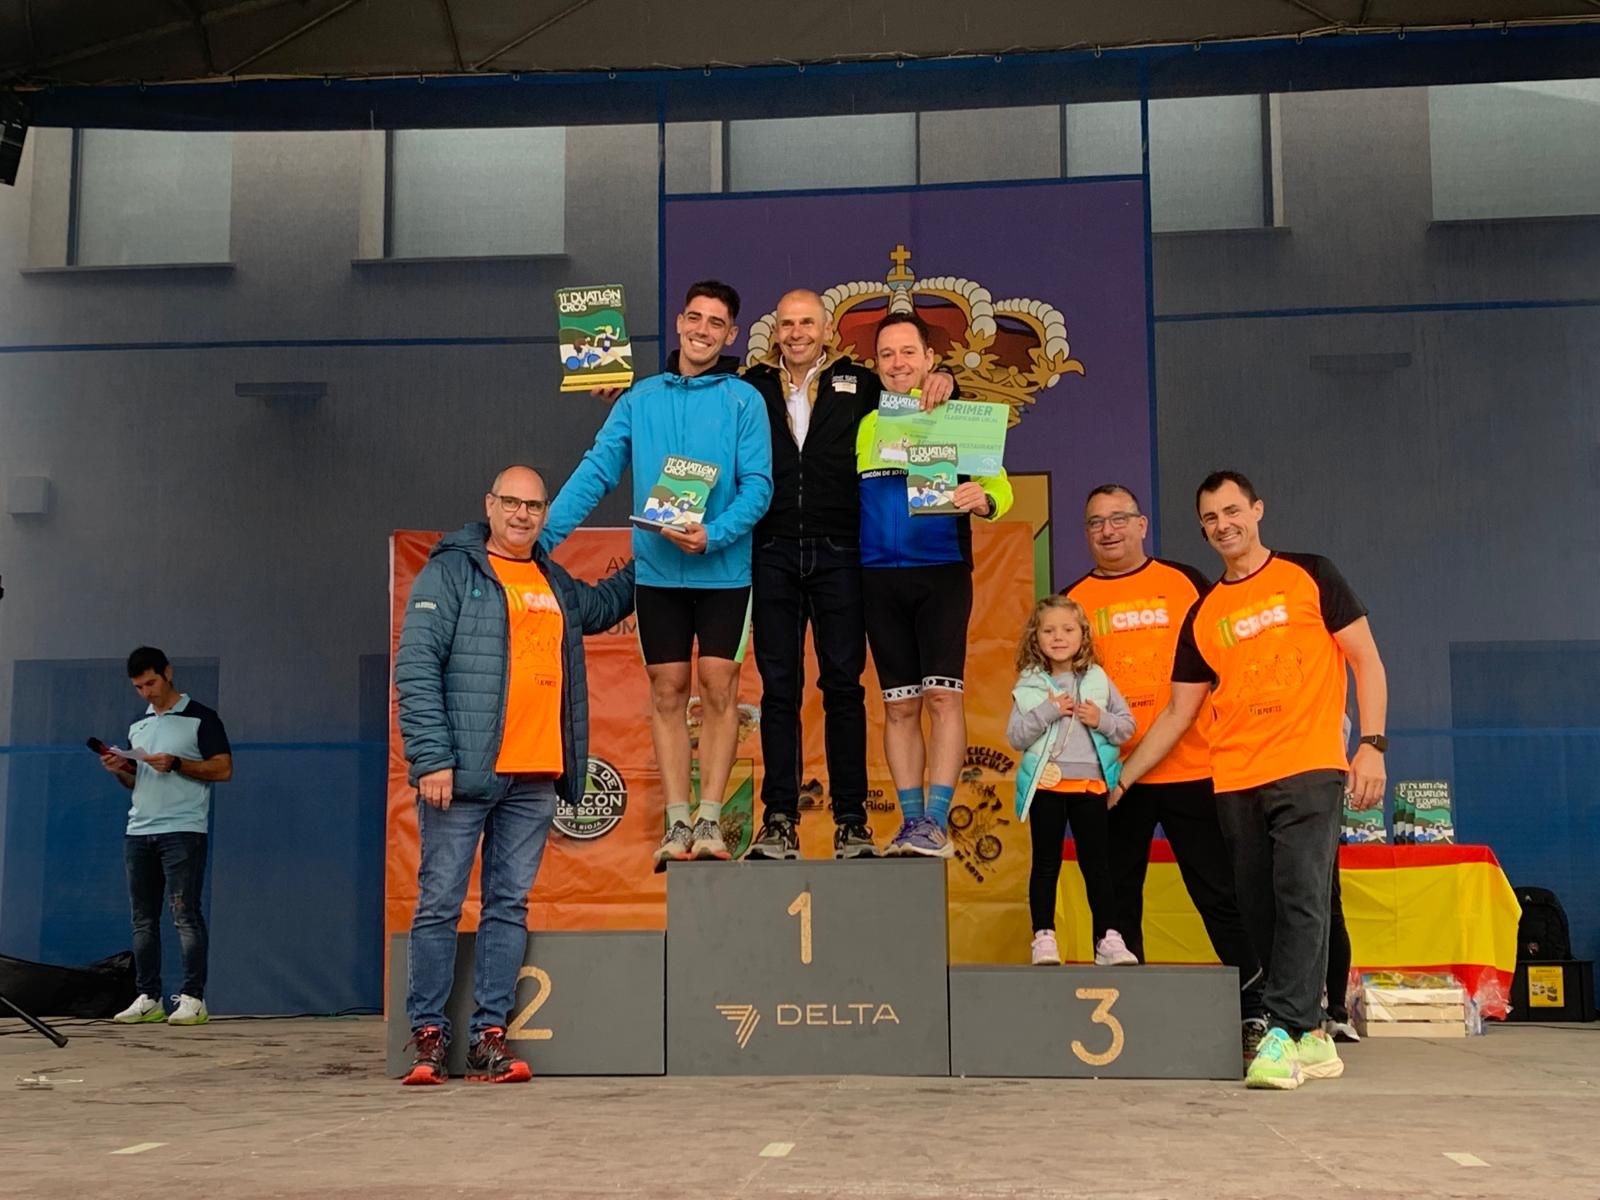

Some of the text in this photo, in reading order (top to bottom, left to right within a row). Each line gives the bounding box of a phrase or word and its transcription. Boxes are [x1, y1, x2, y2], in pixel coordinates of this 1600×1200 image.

[560, 303, 587, 312] CROS
[946, 403, 993, 416] PRIMER
[1112, 608, 1169, 629] CROS
[1235, 605, 1288, 637] CROS
[967, 746, 1014, 770] CICLISTA
[557, 806, 613, 816] DE SOTO
[865, 800, 896, 812] Rioja
[965, 861, 984, 884] SOTO
[787, 891, 812, 964] 1
[505, 965, 553, 1040] 2
[776, 1003, 900, 1025] DELTA
[1071, 988, 1124, 1066] 3
